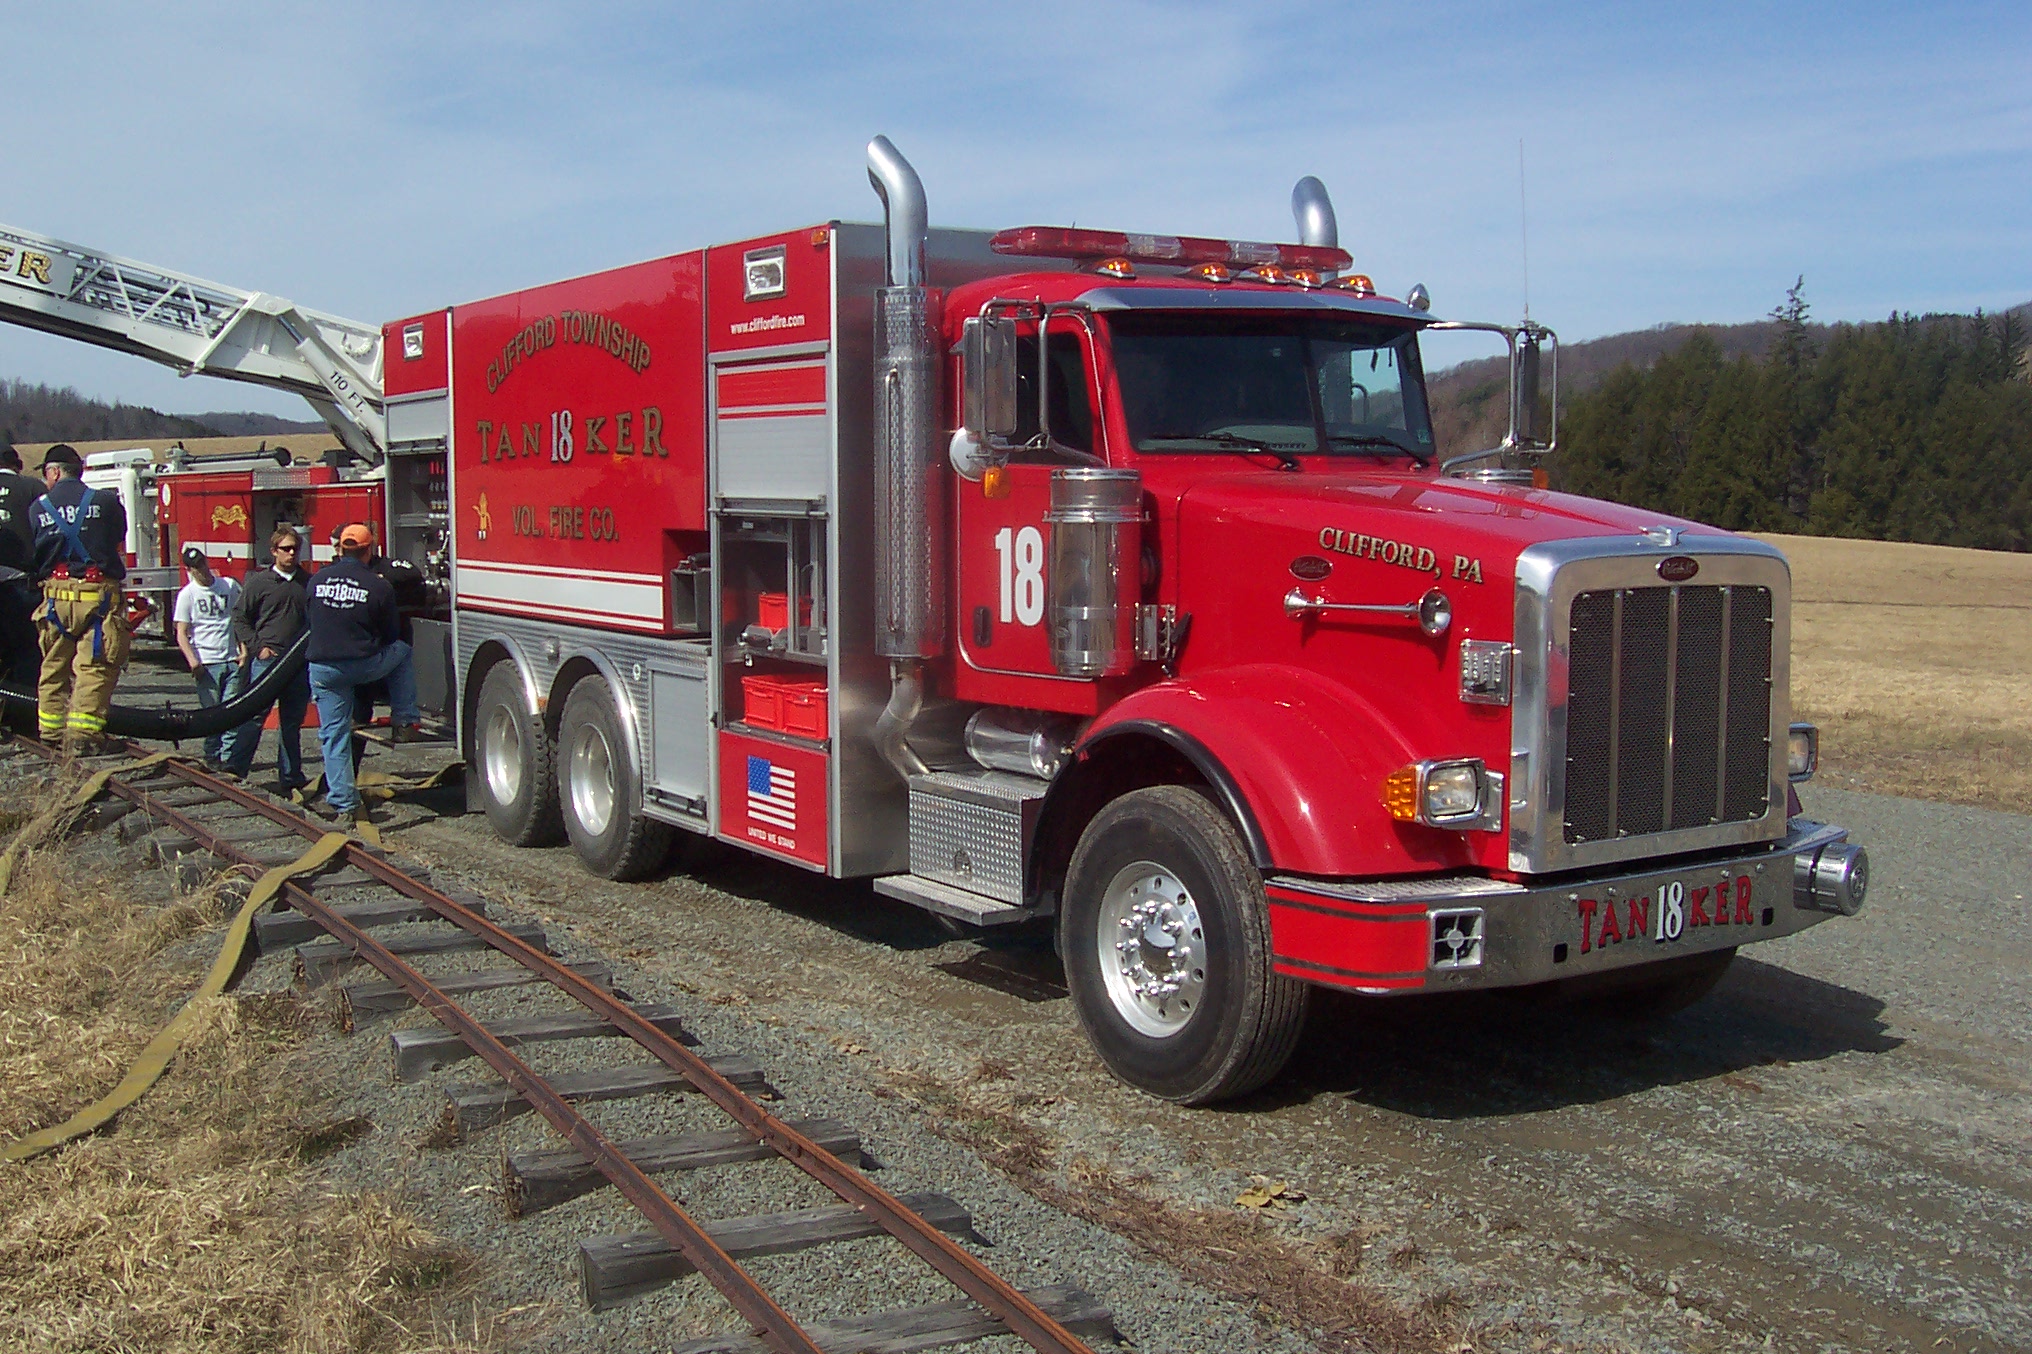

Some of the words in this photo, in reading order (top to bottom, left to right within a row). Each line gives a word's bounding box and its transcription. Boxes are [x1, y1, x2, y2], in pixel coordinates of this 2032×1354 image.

[485, 315, 557, 395] CLIFFORD
[560, 310, 652, 376] TOWNSHIP
[730, 314, 806, 335] www.cliffordfire.com
[330, 371, 349, 391] 110
[348, 391, 365, 413] FT.
[476, 420, 542, 463] TAN
[551, 409, 575, 463] 18
[584, 405, 670, 458] KER
[511, 505, 545, 538] VOL.
[550, 506, 585, 540] FIRE
[589, 506, 621, 542] CO.
[994, 525, 1045, 627] 18
[1318, 526, 1443, 580] CLIFFORD,
[1451, 554, 1485, 584] PA
[1577, 897, 1650, 955] TAN
[1654, 880, 1686, 944] 18
[1689, 875, 1755, 928] KER
